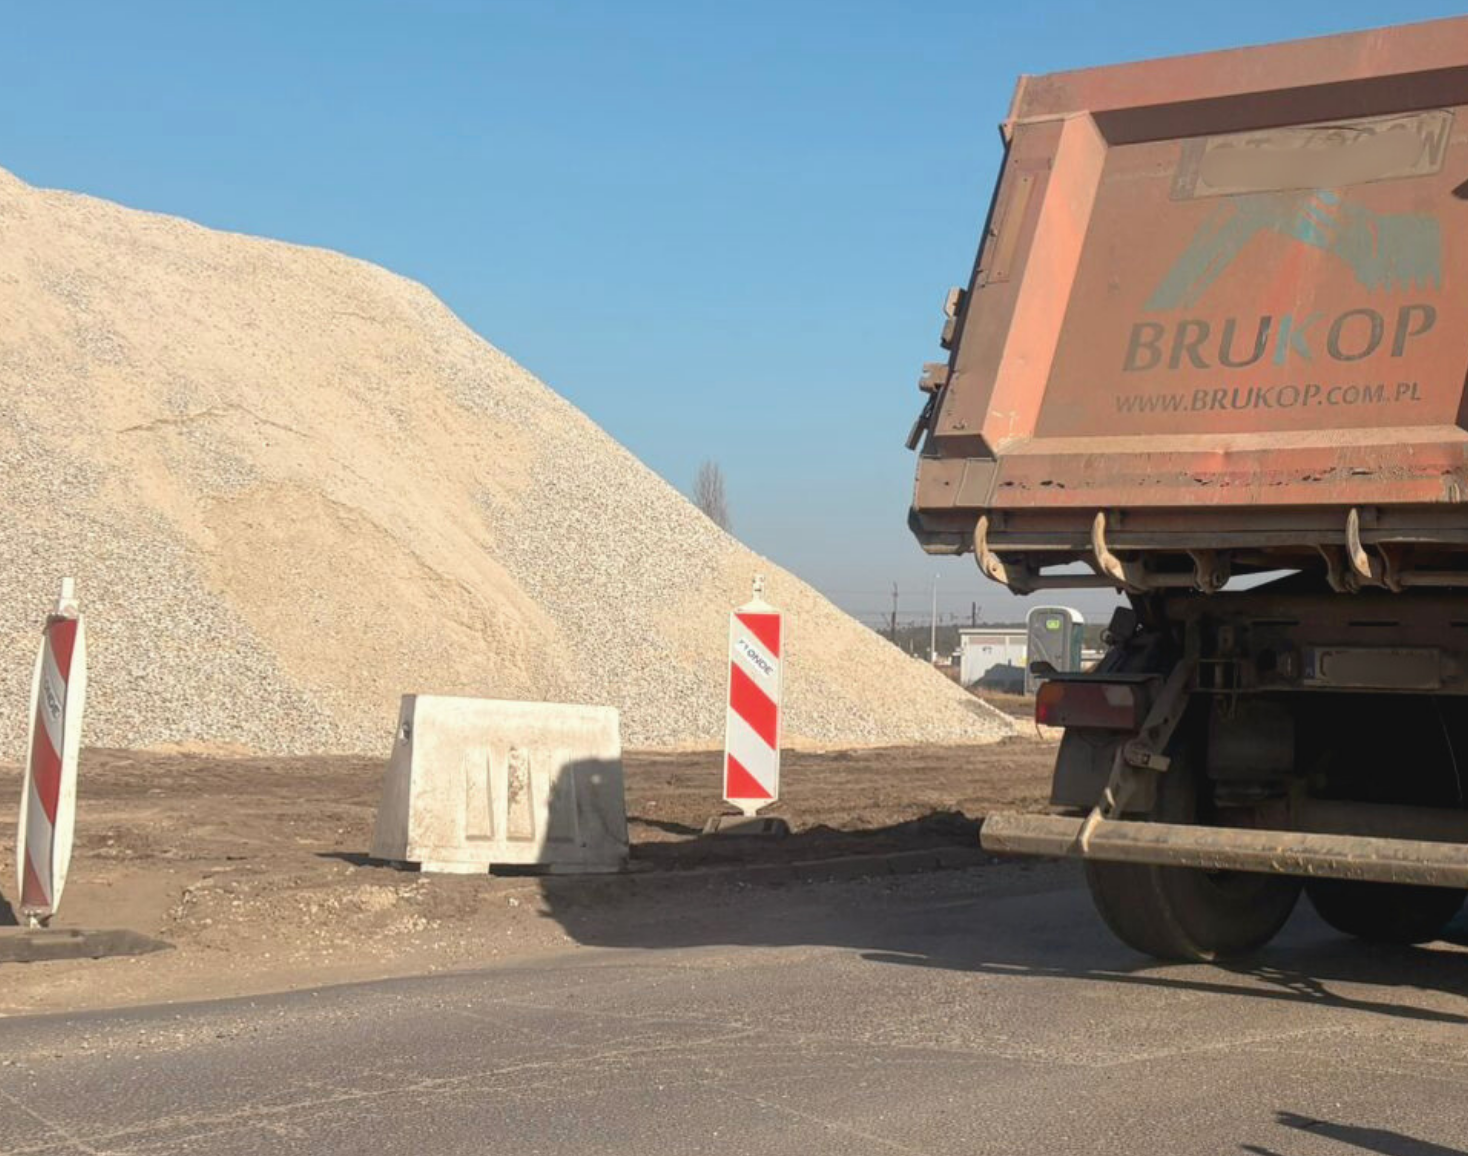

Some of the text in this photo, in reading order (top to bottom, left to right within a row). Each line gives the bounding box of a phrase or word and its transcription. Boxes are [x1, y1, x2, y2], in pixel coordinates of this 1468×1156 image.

[1122, 304, 1437, 372] BRUKOP
[1115, 382, 1421, 414] WWW.BRUKOP.COM.PL
[747, 649, 774, 676] ONDE
